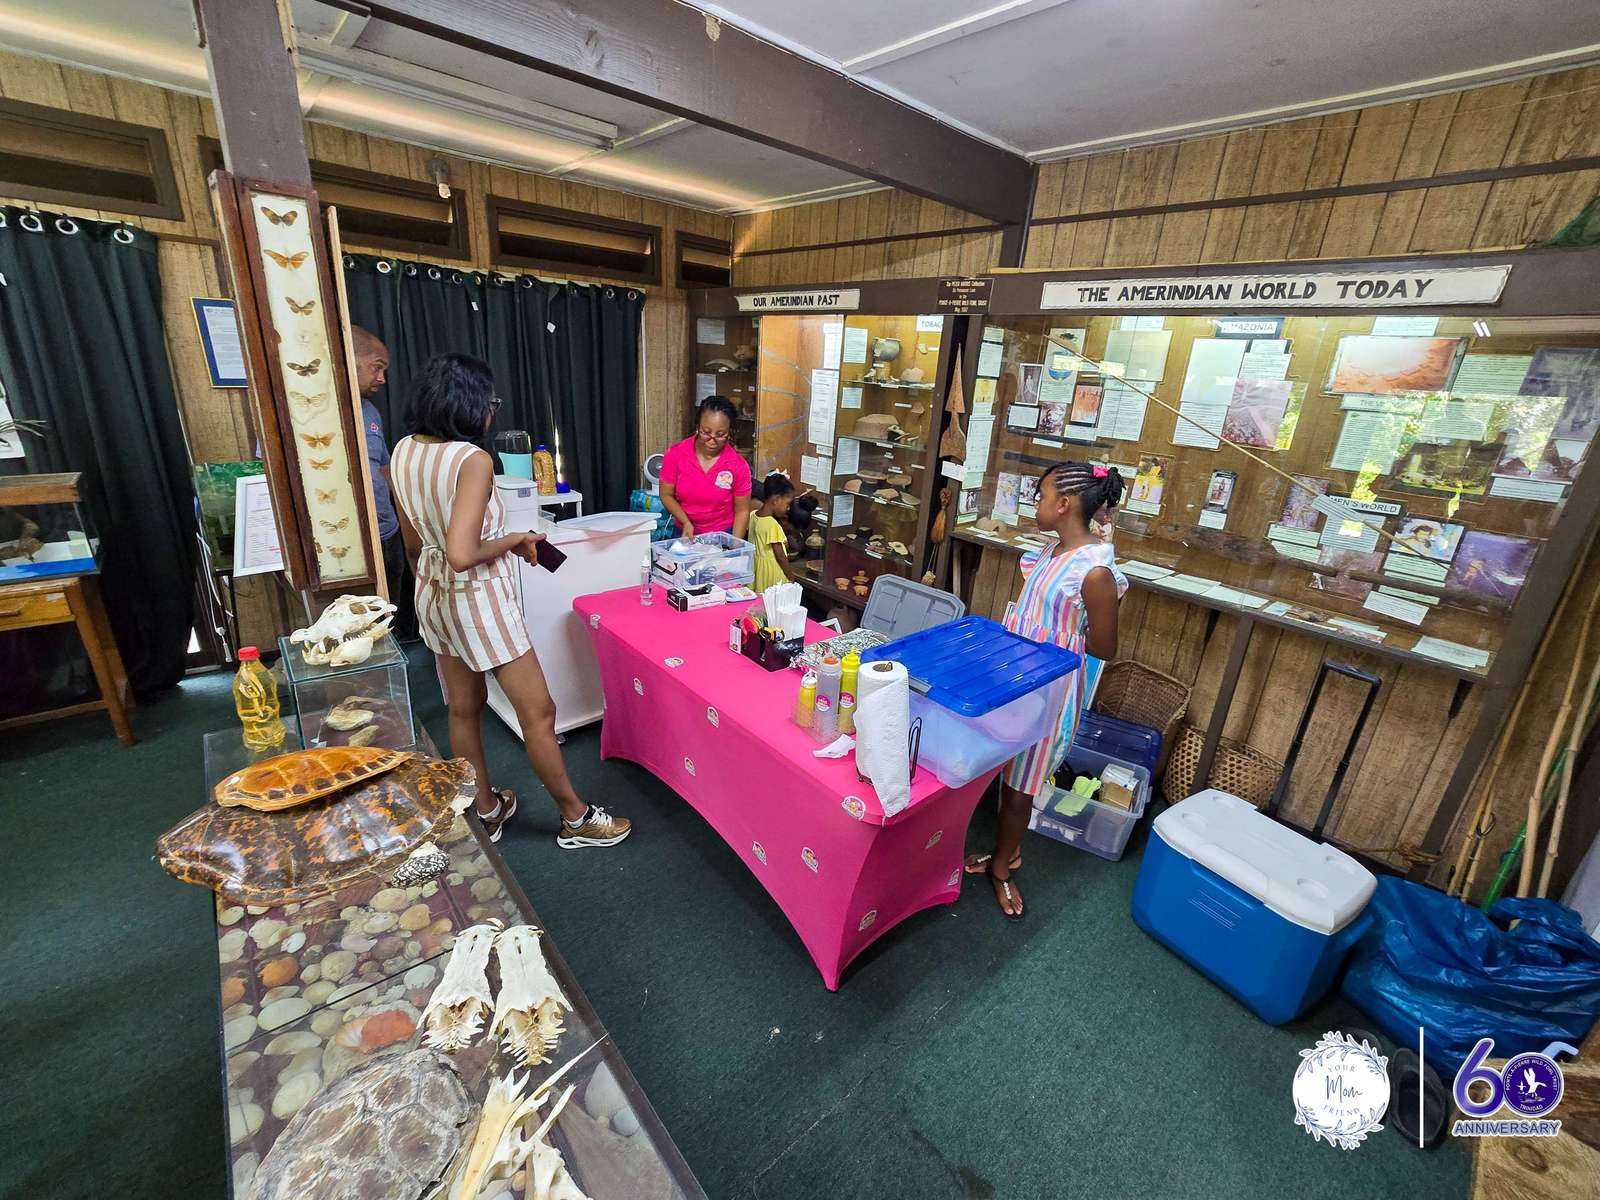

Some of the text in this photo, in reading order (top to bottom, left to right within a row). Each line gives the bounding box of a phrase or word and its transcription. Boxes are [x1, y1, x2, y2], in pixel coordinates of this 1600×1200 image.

[1077, 278, 1435, 303] THE AMERINDIAN WORLD TODAY
[753, 294, 840, 307] OUR AMERINDIAN PAST
[1360, 502, 1398, 513] WORLD
